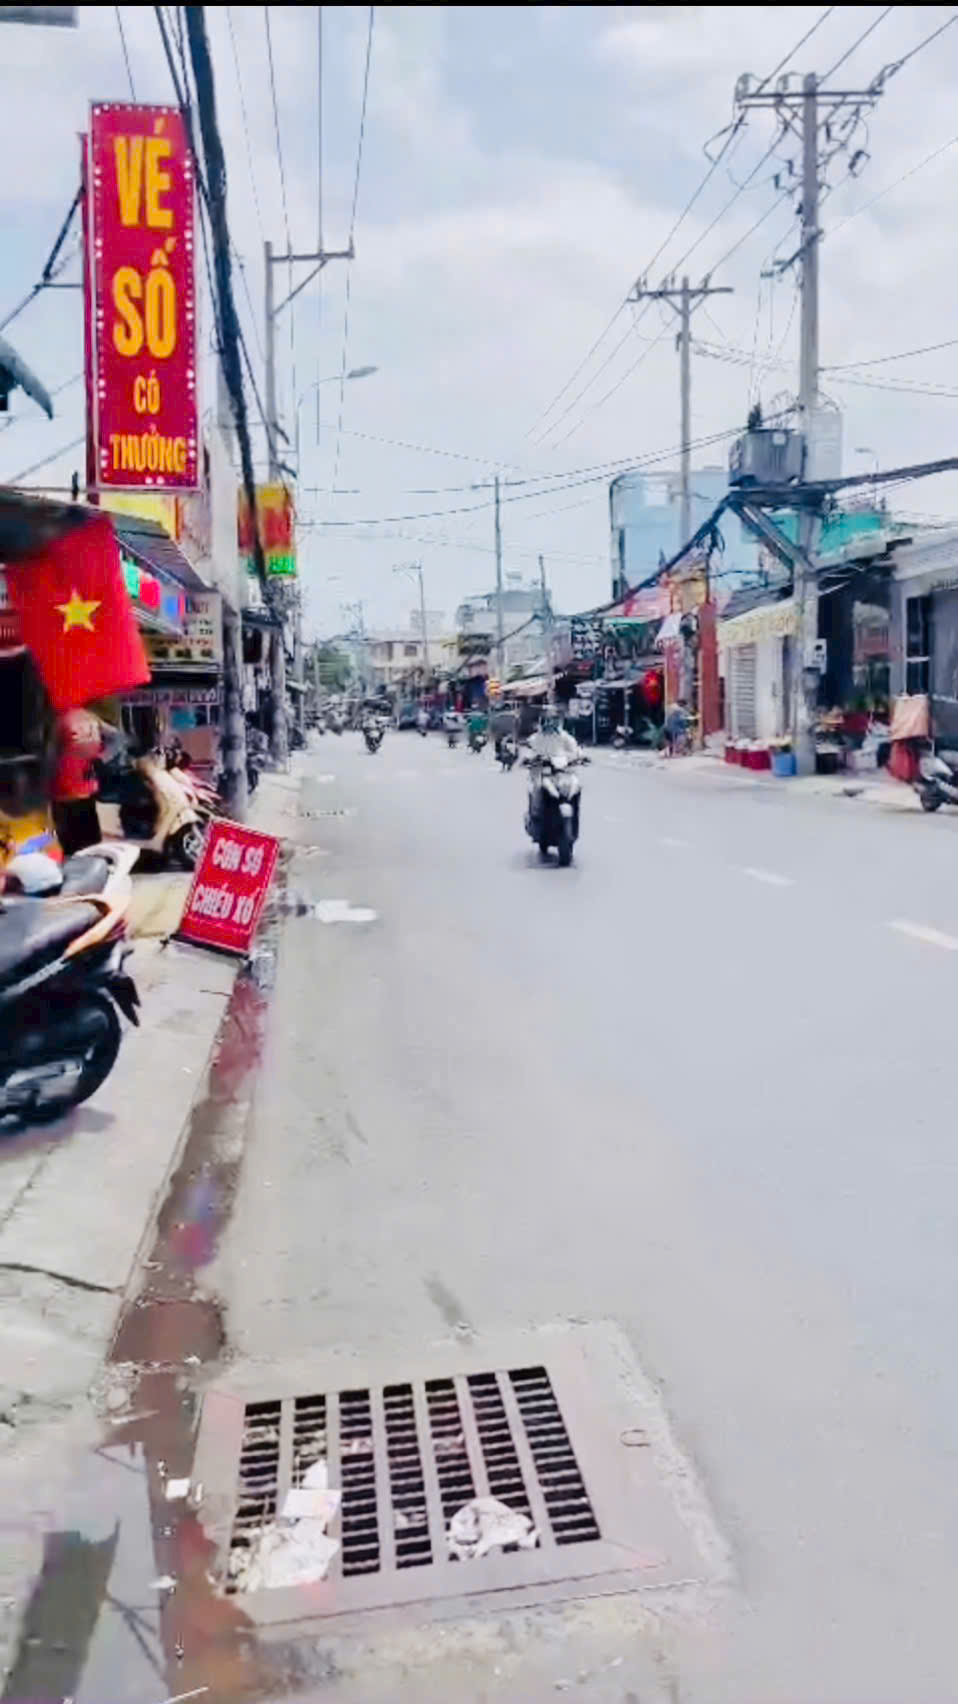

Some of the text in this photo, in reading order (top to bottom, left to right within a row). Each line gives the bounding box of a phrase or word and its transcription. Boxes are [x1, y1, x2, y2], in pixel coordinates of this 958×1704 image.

[114, 117, 173, 228] VÉ
[112, 238, 177, 358] SỐ
[134, 369, 161, 415] CÓ
